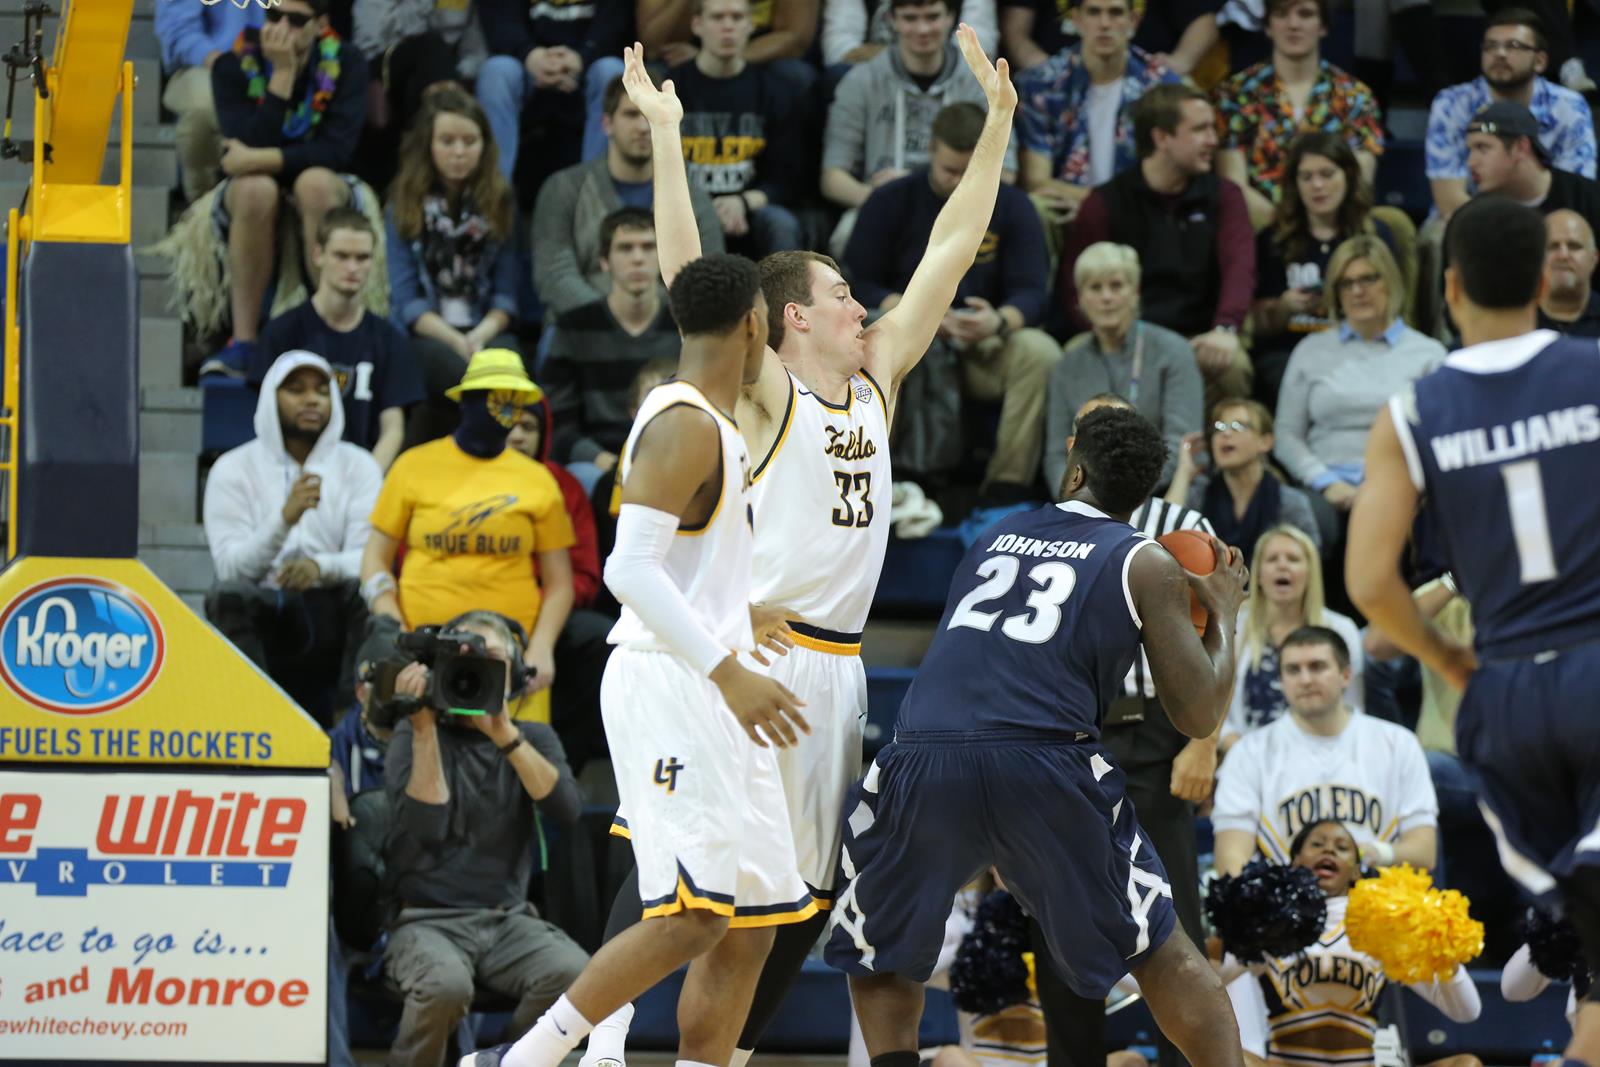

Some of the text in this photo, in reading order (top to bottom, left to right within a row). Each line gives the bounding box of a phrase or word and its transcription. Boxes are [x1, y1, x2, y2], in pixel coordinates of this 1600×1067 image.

[1430, 404, 1600, 472] WILLIAMS
[832, 470, 874, 528] 33
[1501, 459, 1559, 585] 1
[986, 534, 1096, 560] JOHNSON
[947, 554, 1077, 644] 23
[16, 597, 148, 698] Kroger
[0, 728, 272, 760] FUELS THE ROCKETS
[96, 789, 307, 857] white
[1279, 785, 1382, 838] TOLEDO
[80, 926, 117, 953] to
[133, 933, 176, 966] go
[25, 965, 89, 1004] and
[106, 967, 309, 1008] Monroe
[1280, 955, 1377, 1003] TOLEDO
[0, 1017, 187, 1041] ewhitechevy.com
